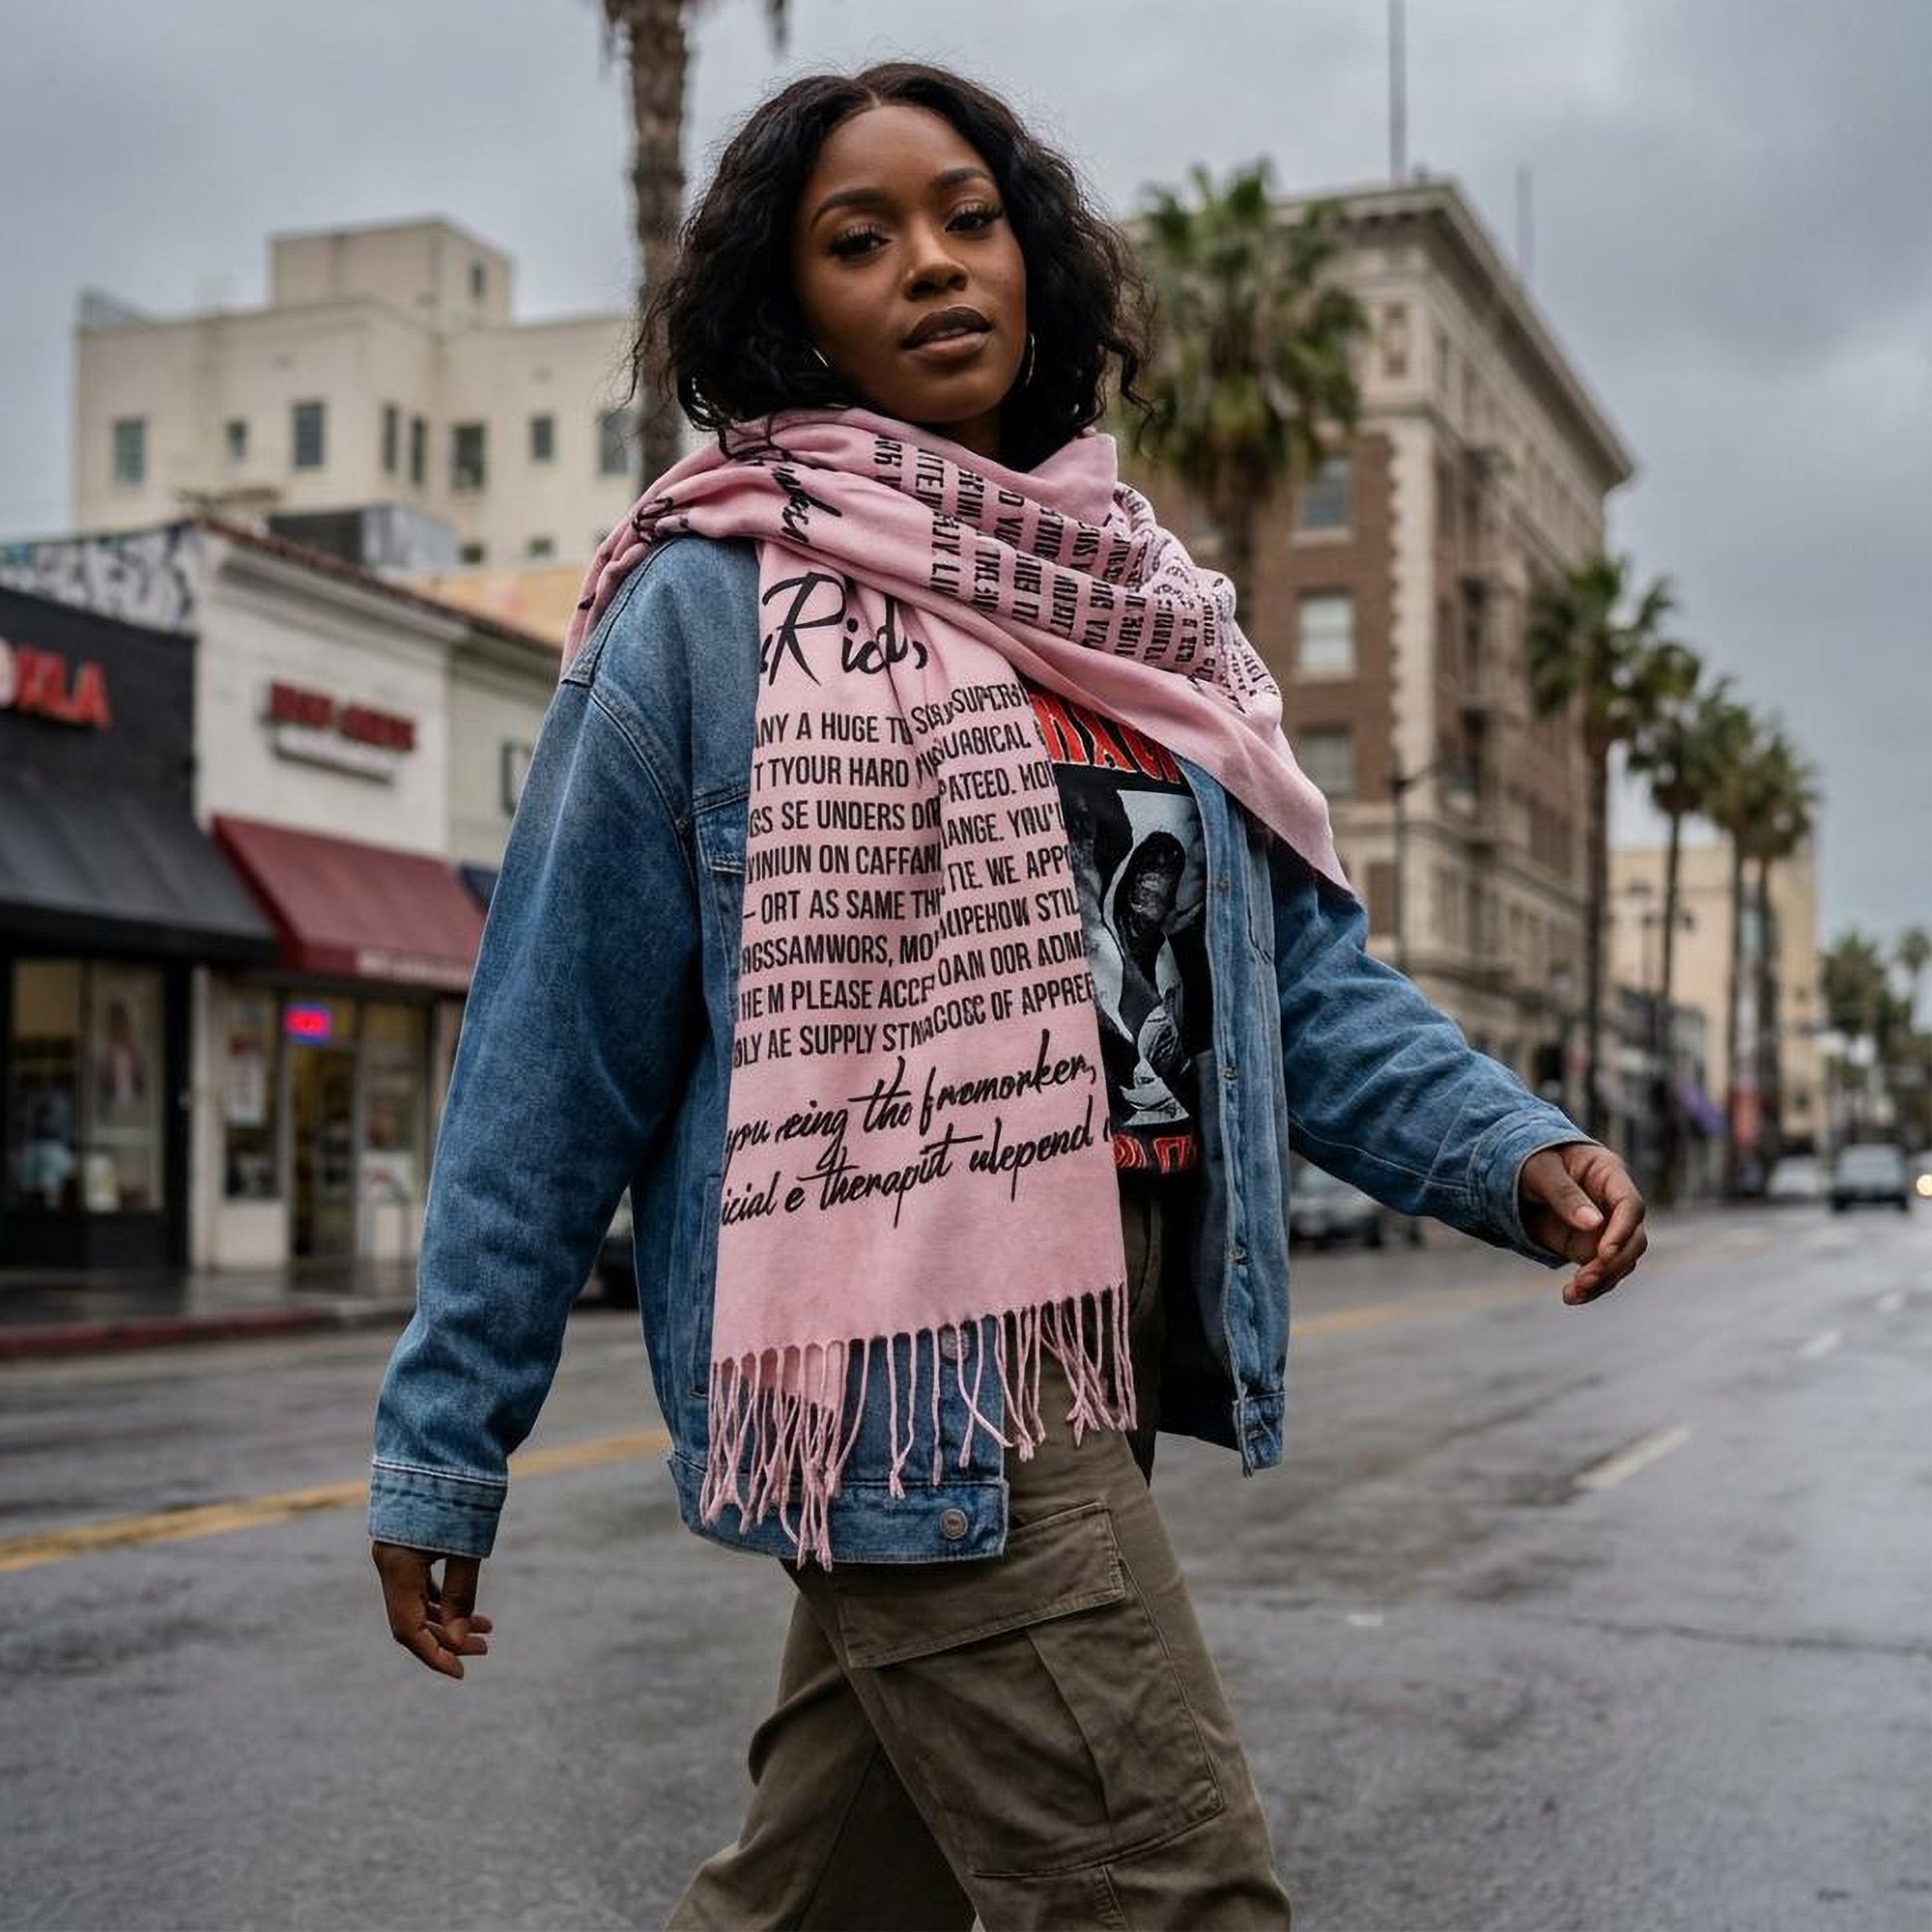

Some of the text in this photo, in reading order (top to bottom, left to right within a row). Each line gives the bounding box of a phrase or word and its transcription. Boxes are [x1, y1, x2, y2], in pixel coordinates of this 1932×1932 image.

[796, 712, 811, 740] A
[821, 713, 880, 743] HUGE
[768, 755, 841, 787] TYOUR
[781, 800, 810, 831] SE
[816, 800, 905, 831] UNDERS
[819, 845, 849, 874] ON
[761, 891, 801, 924] ORT
[810, 890, 839, 919] AS
[846, 890, 905, 920] SAME
[985, 856, 1021, 887] WE
[768, 983, 784, 1013] M
[791, 980, 872, 1011] PLEASE
[767, 1027, 792, 1060] AE
[799, 1024, 877, 1056] SUPPLY
